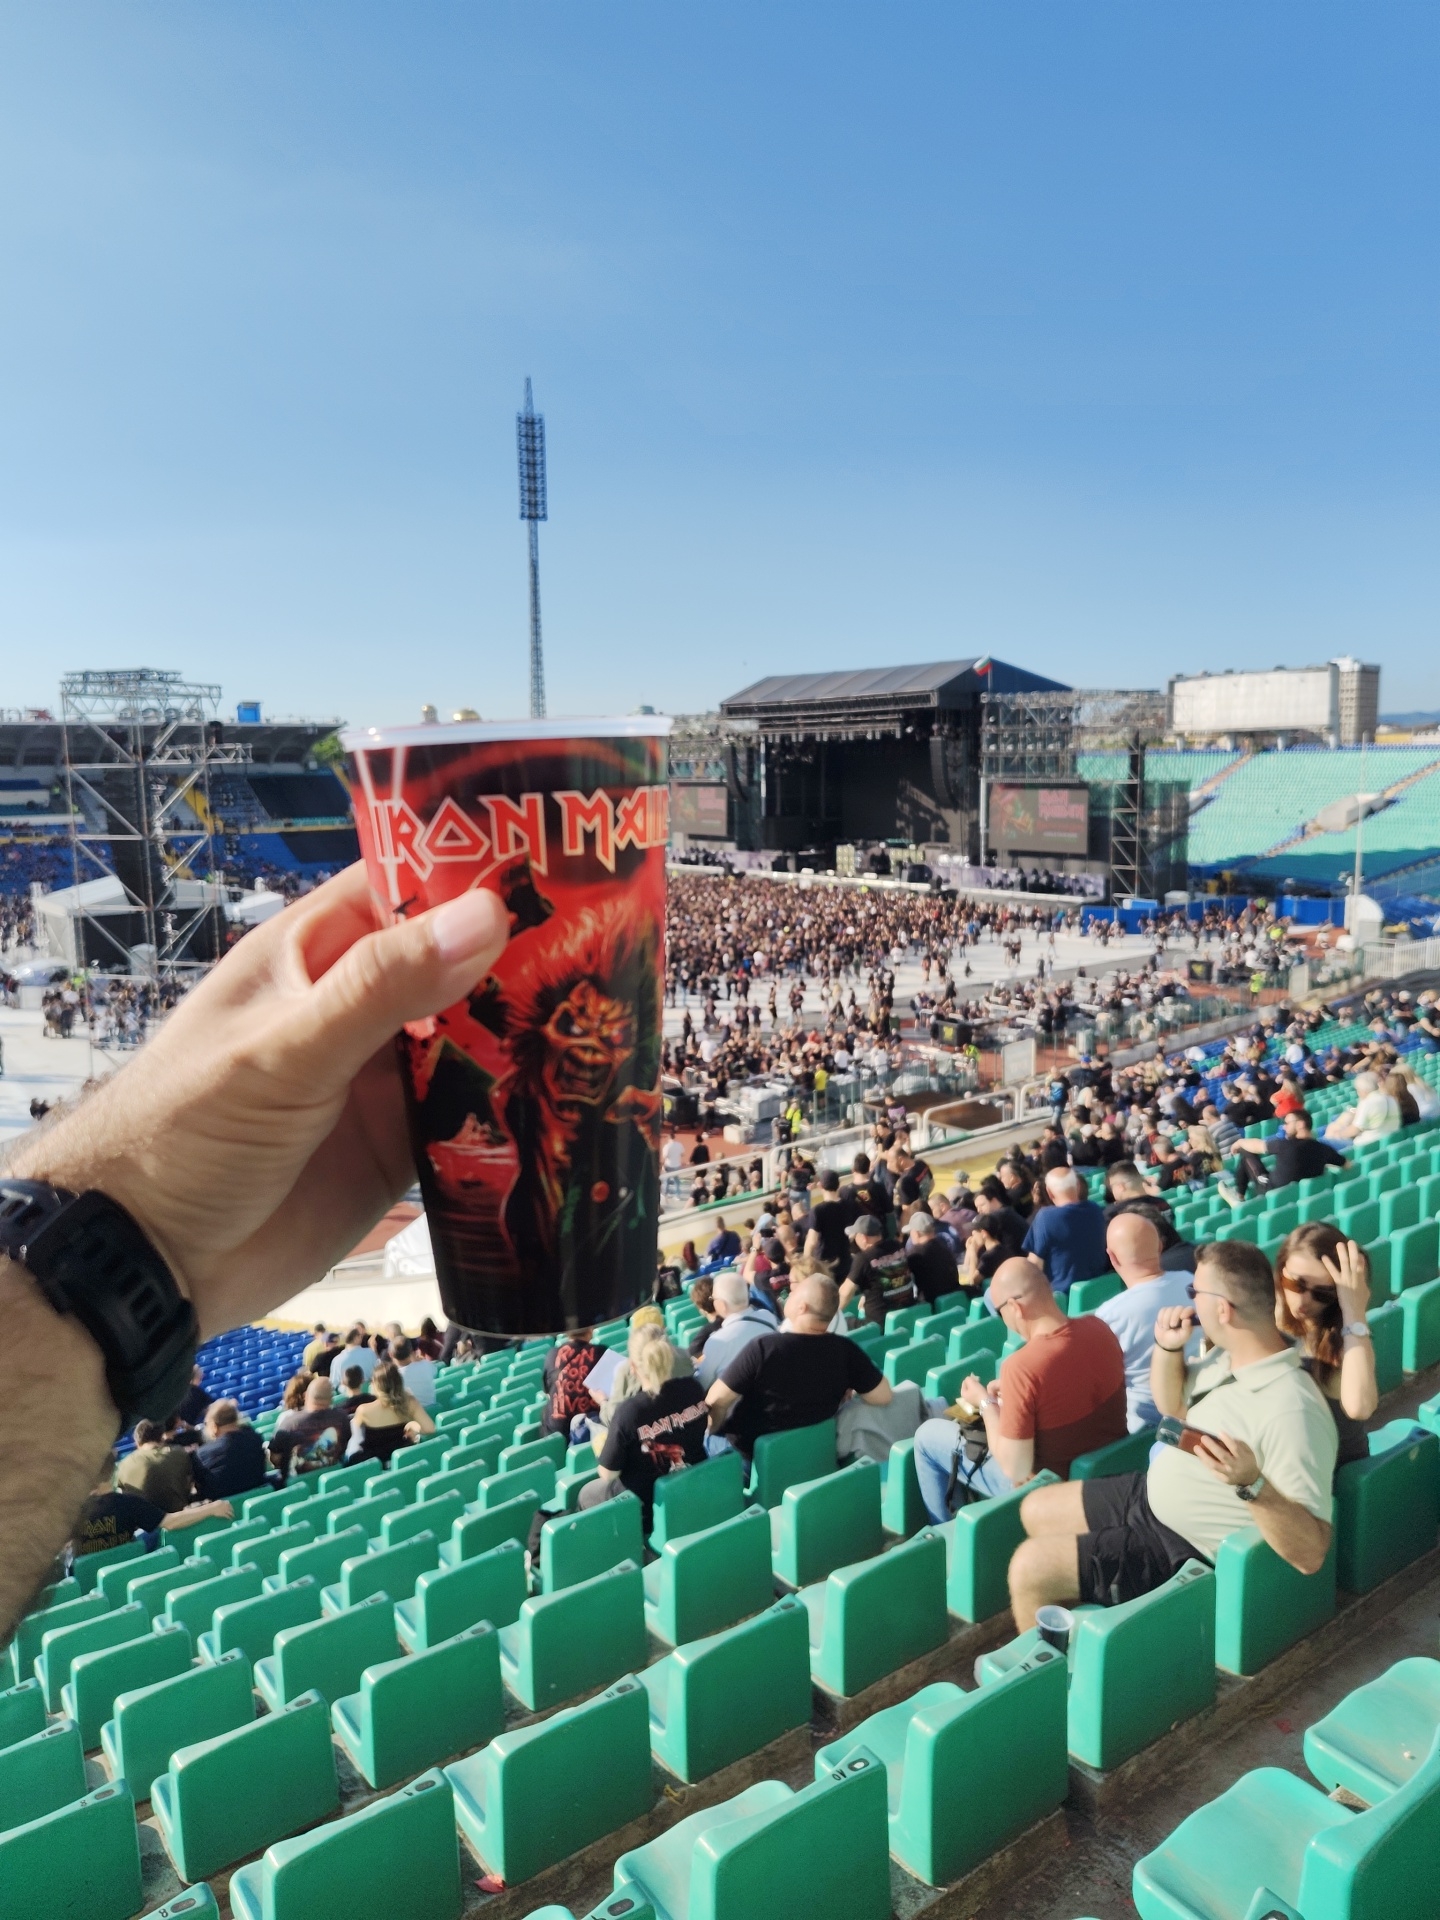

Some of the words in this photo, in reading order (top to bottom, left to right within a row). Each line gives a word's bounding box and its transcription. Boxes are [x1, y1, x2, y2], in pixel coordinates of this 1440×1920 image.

[372, 793, 547, 881] IRON
[637, 1416, 673, 1441] IRON
[158, 1908, 169, 1918] 8
